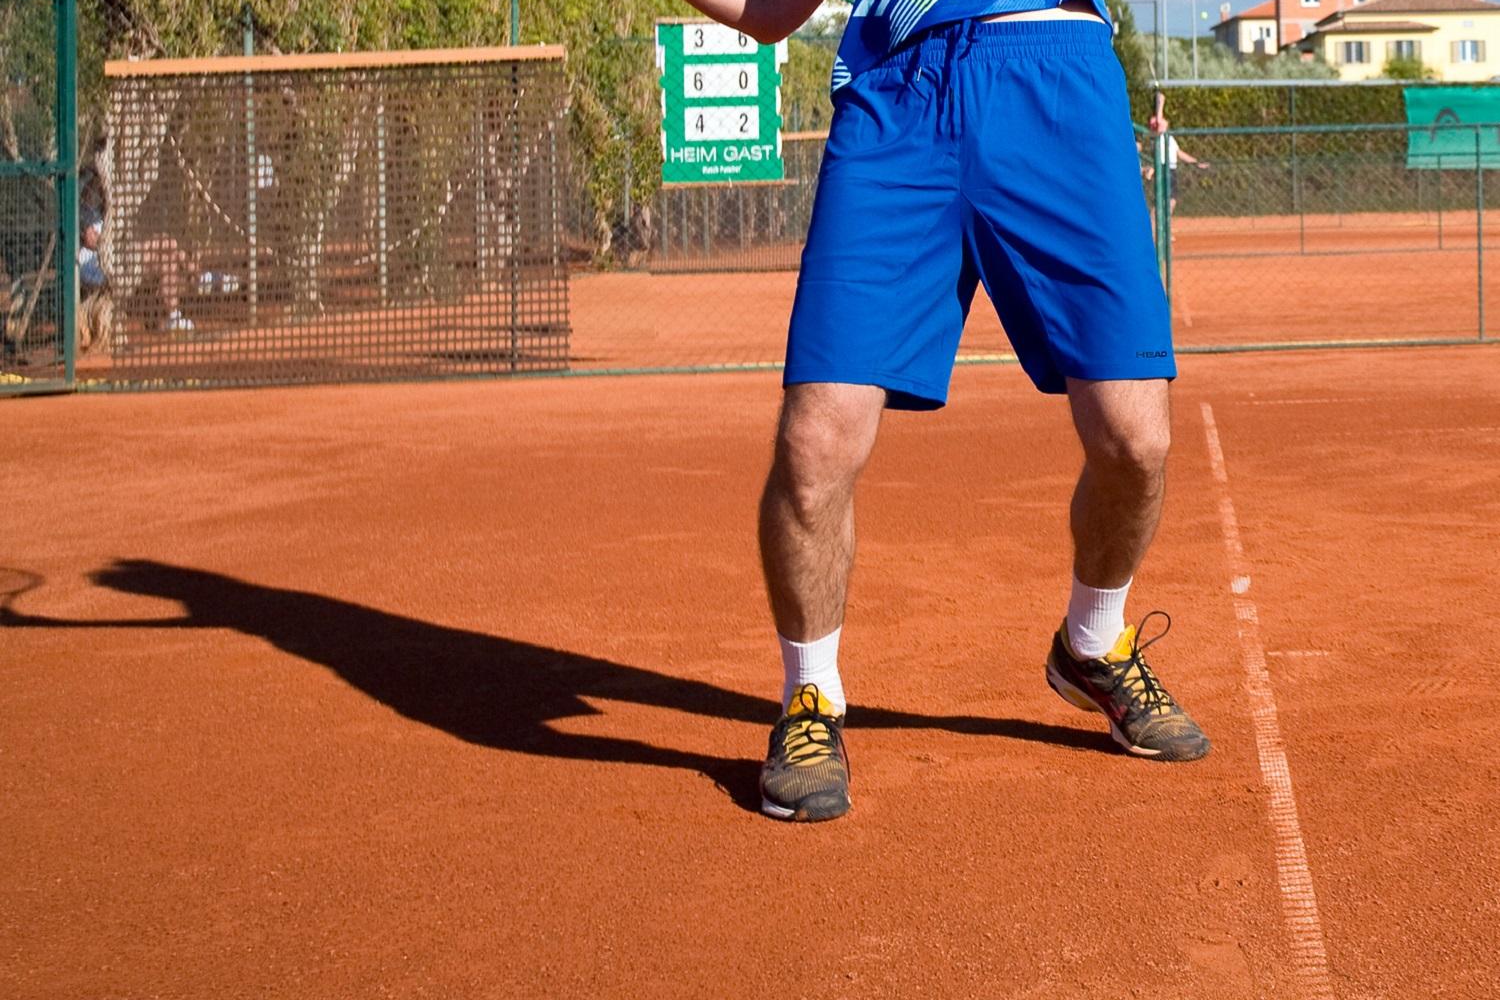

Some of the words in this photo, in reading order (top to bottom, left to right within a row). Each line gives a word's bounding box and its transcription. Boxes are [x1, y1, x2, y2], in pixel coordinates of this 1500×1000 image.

[694, 29, 704, 48] 3
[738, 30, 748, 48] 6
[693, 72, 704, 91] 6
[738, 70, 749, 90] 0
[695, 113, 705, 133] 4
[739, 113, 749, 132] 2
[671, 146, 717, 163] HEIM
[723, 144, 774, 163] GAST
